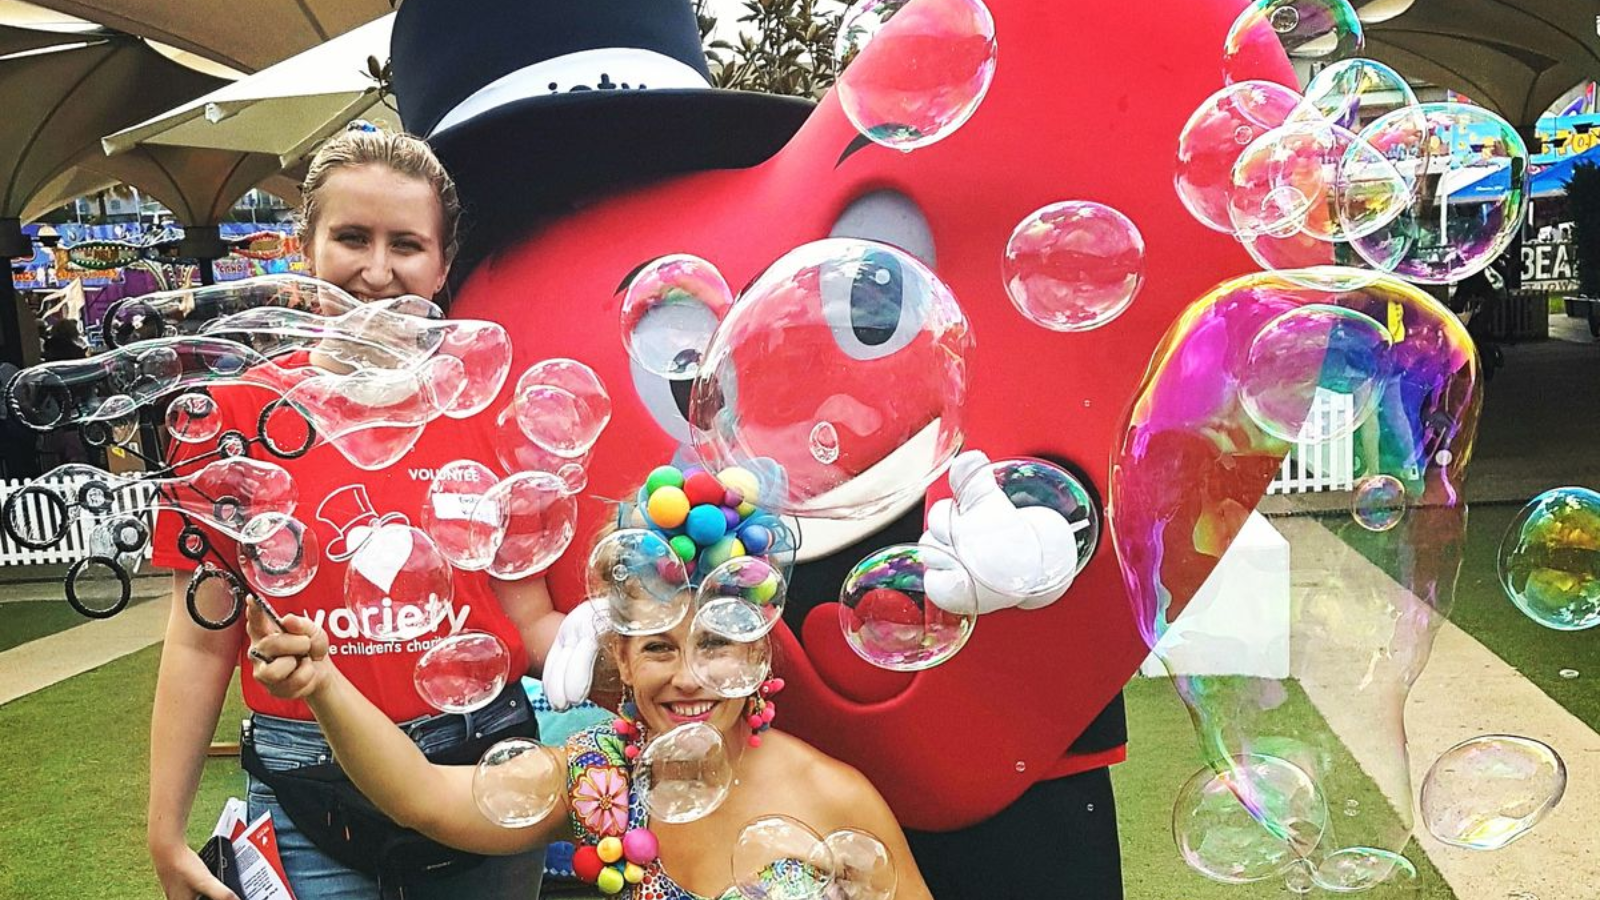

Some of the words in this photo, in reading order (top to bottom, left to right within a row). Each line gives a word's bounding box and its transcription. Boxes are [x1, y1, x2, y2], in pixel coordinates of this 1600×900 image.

[1520, 245, 1577, 280] BEA
[303, 592, 471, 639] variety
[341, 640, 402, 655] children's
